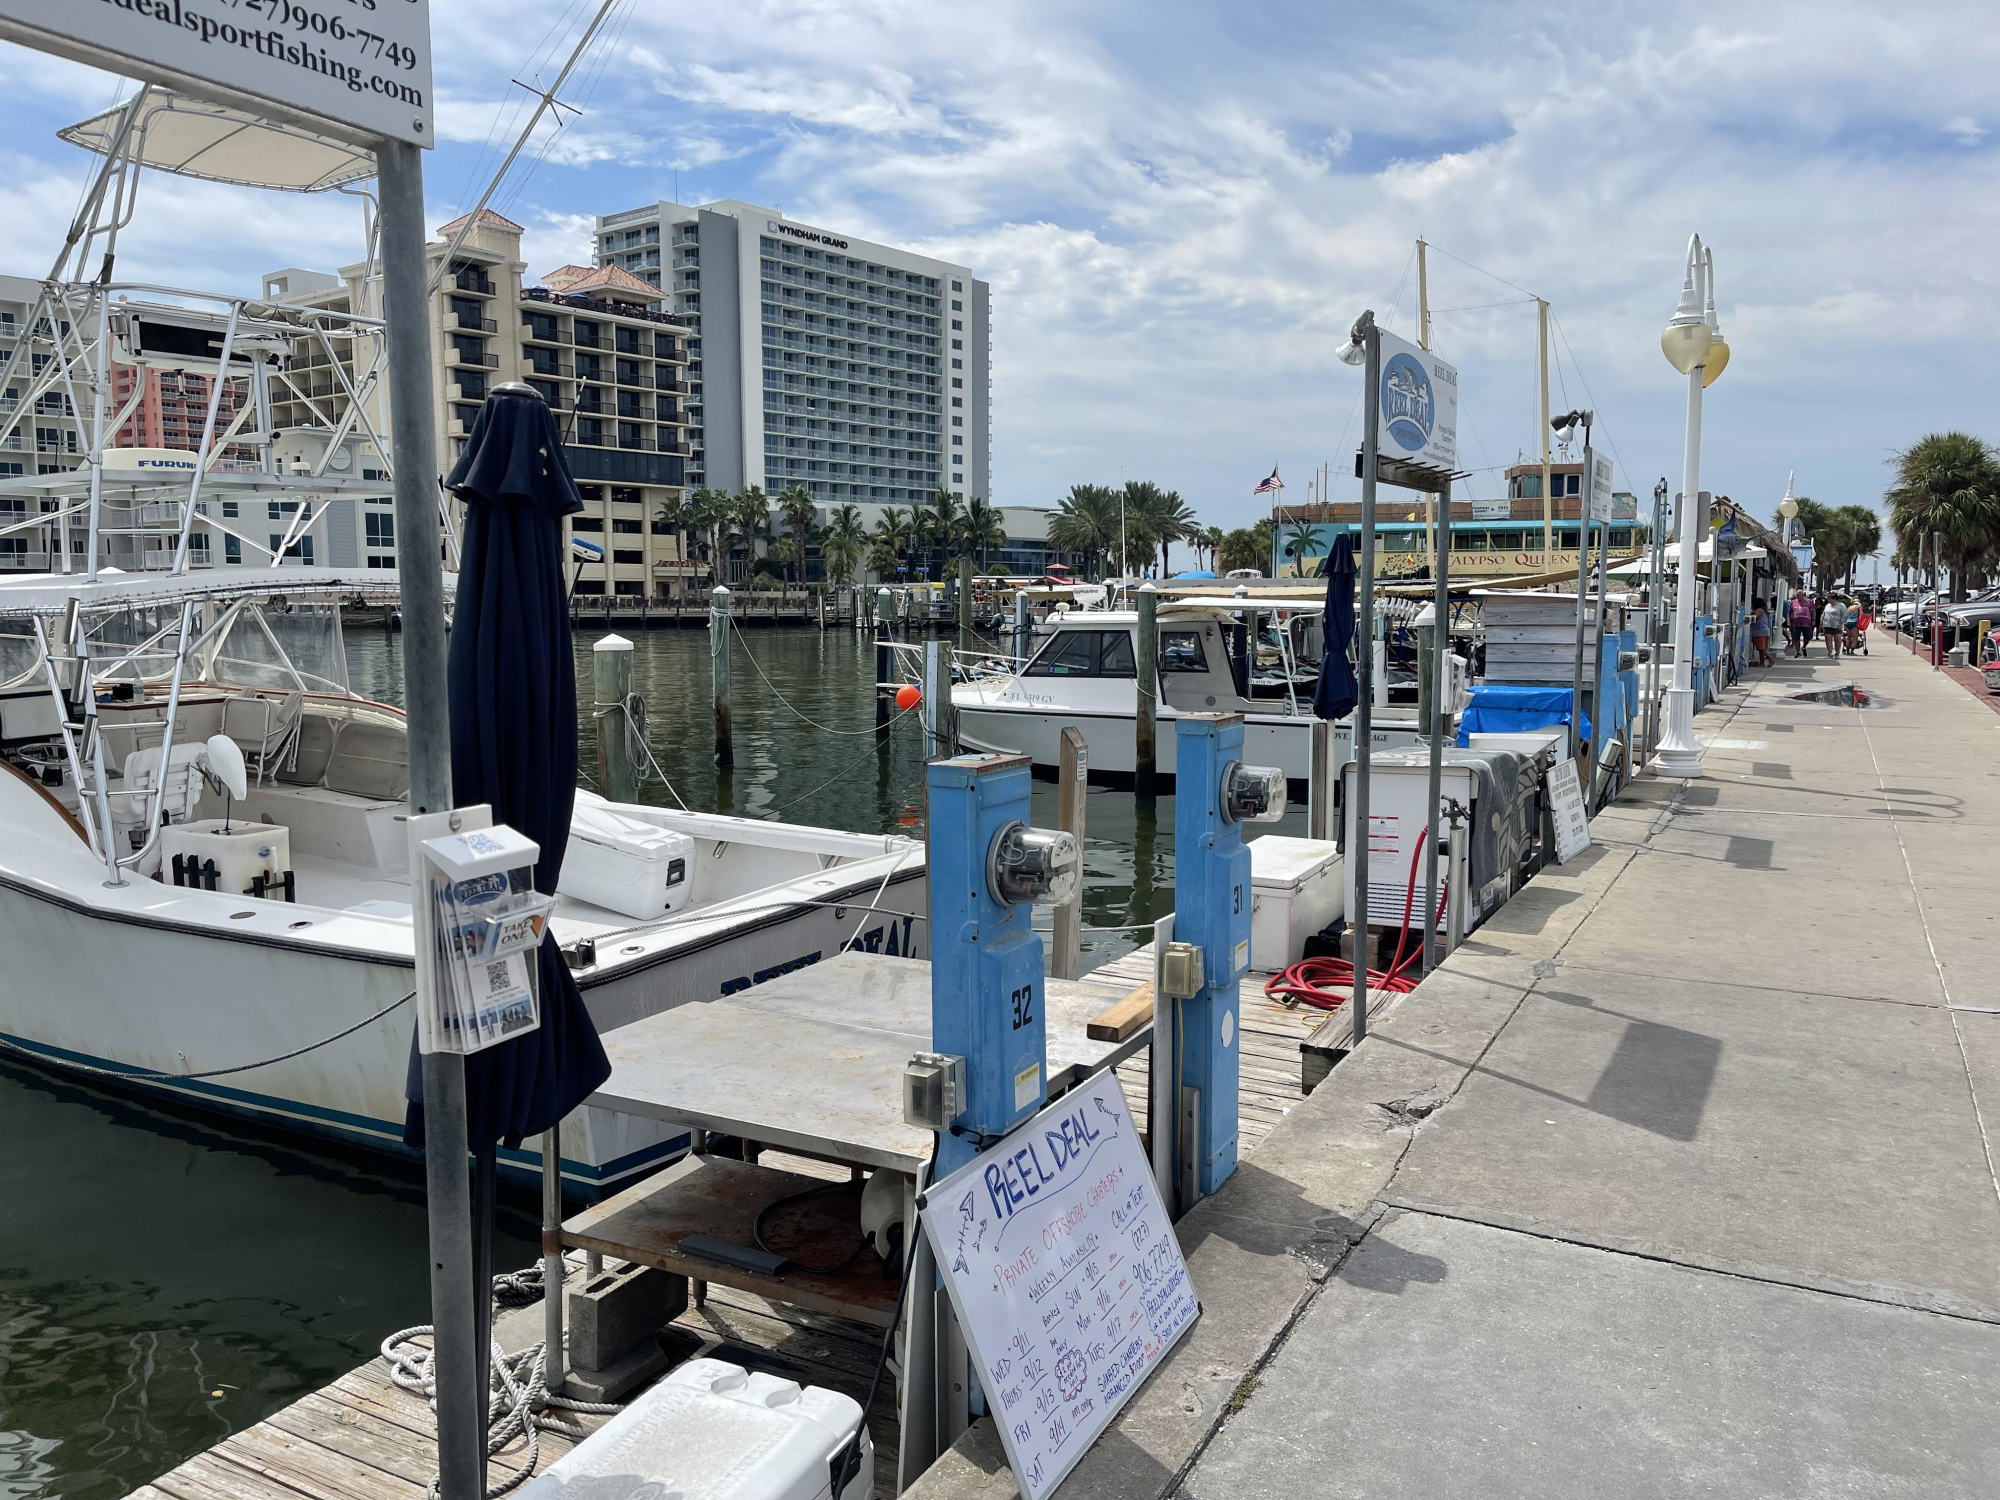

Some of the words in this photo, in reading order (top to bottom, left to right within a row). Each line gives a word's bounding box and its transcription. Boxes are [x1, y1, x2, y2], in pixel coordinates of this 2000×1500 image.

[219, 0, 417, 71] 7)906-7749
[98, 0, 423, 107] ealsportfishing.com
[778, 224, 821, 243] WYNDHAM
[821, 235, 848, 250] GRAND
[1387, 387, 1409, 421] REEL
[1410, 397, 1430, 438] DEAL
[1233, 884, 1243, 916] 31
[501, 930, 528, 944] ONE
[504, 918, 529, 934] TAKE
[840, 914, 916, 958] EAL
[1011, 985, 1032, 1030] 32
[984, 1142, 1054, 1219] REEL
[1045, 1108, 1100, 1171] DEAL
[1112, 1206, 1128, 1228] CALL
[994, 1247, 1039, 1295] PRIVATE
[1042, 1203, 1087, 1250] OFFSHORE
[991, 1358, 1011, 1384] WED
[1001, 1387, 1022, 1411] THURS
[1014, 1420, 1031, 1444] FRI
[1027, 1453, 1045, 1487] SAT
